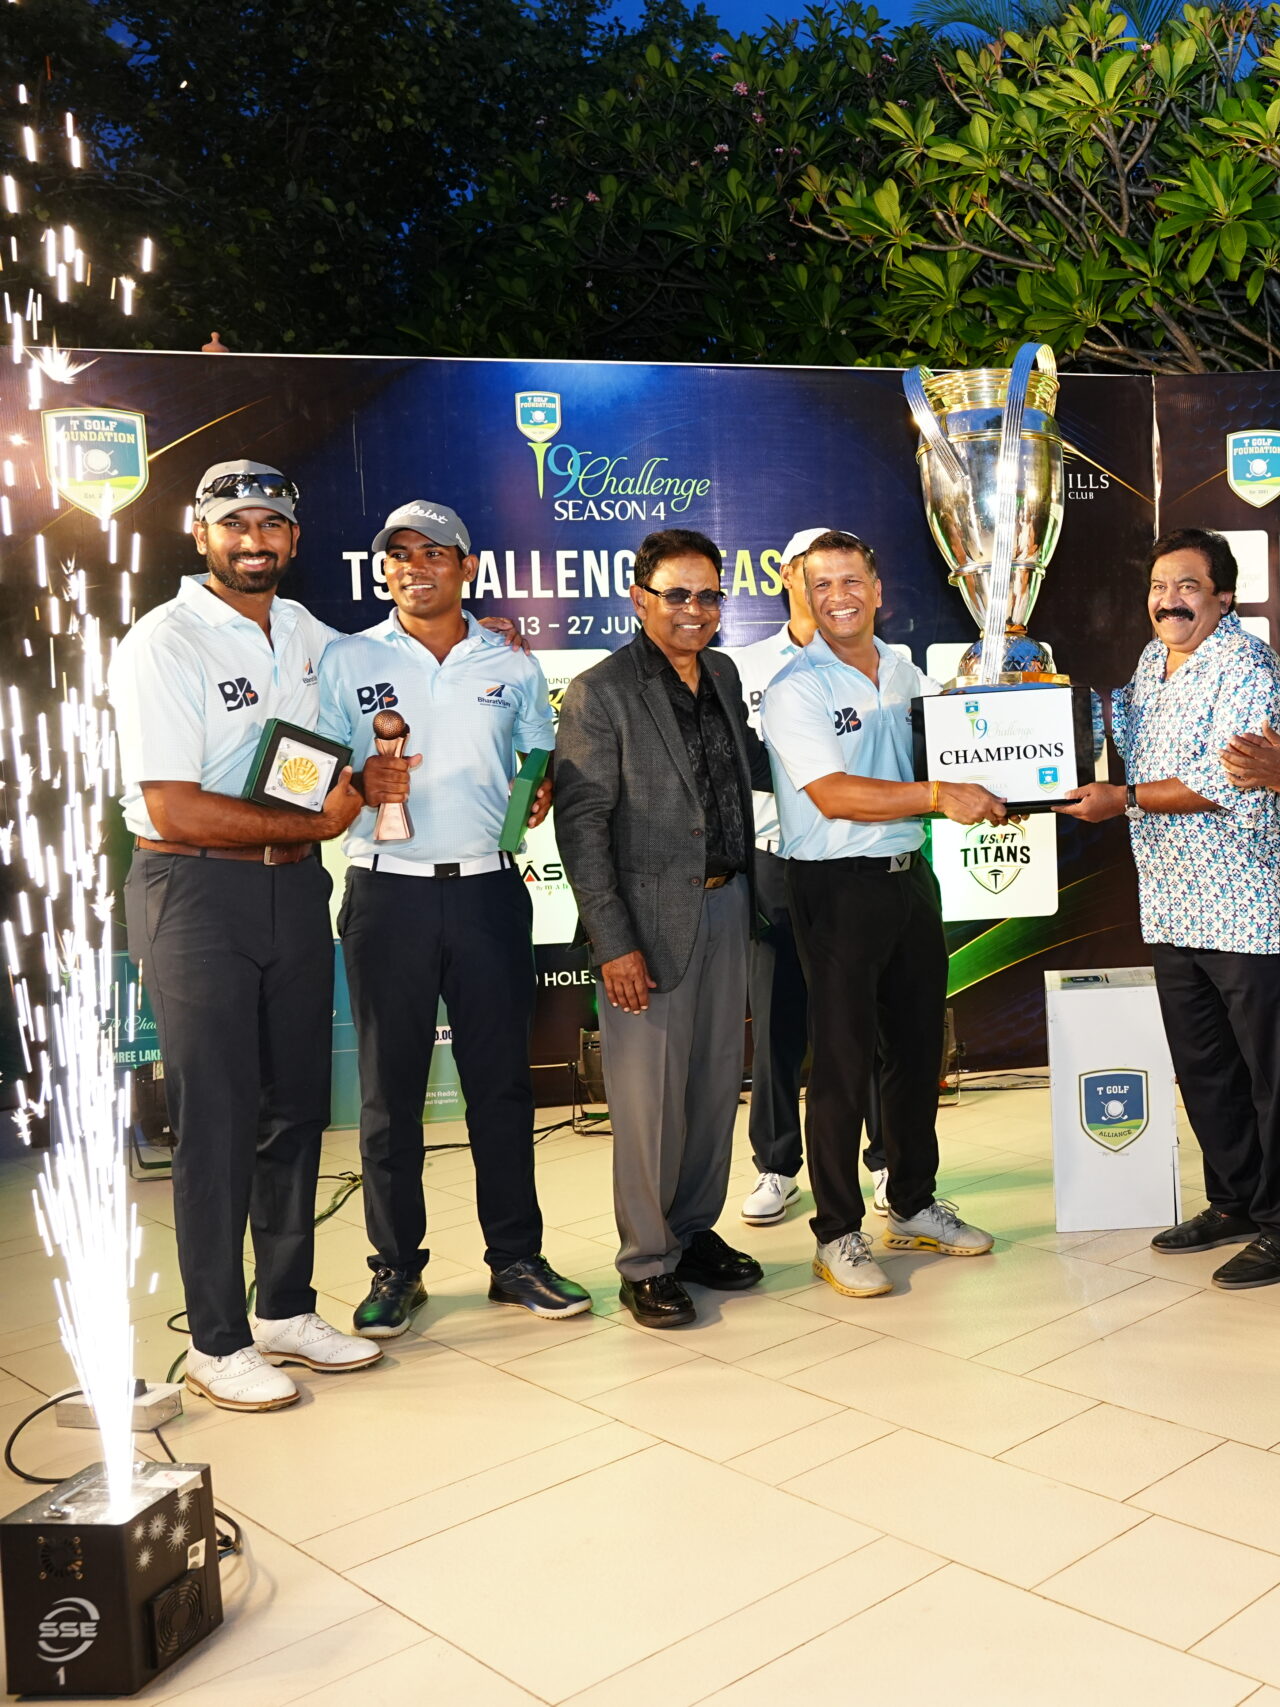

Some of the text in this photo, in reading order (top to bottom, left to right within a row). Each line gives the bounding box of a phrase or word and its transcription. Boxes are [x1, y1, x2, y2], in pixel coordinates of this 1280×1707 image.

[84, 419, 118, 432] GOLF
[63, 430, 136, 444] OUNDATION
[1251, 438, 1273, 447] GOLF
[566, 451, 712, 513] Challenge
[1068, 473, 1110, 489] ILLS
[1068, 491, 1094, 500] CLUB
[554, 500, 667, 521] SEASON 4
[342, 549, 636, 601] T9 ALLENG
[518, 616, 541, 636] 13
[567, 616, 594, 635] 27
[601, 616, 642, 634] JUN
[939, 742, 1065, 766] CHAMPIONS
[960, 845, 1031, 868] TITANS
[544, 970, 598, 987] HOLE
[112, 1050, 137, 1063] HREE
[1096, 1085, 1130, 1096] T GOLF
[1098, 1129, 1133, 1138] ALLIANCE
[38, 1621, 98, 1638] SSE
[56, 1666, 66, 1686] 1
